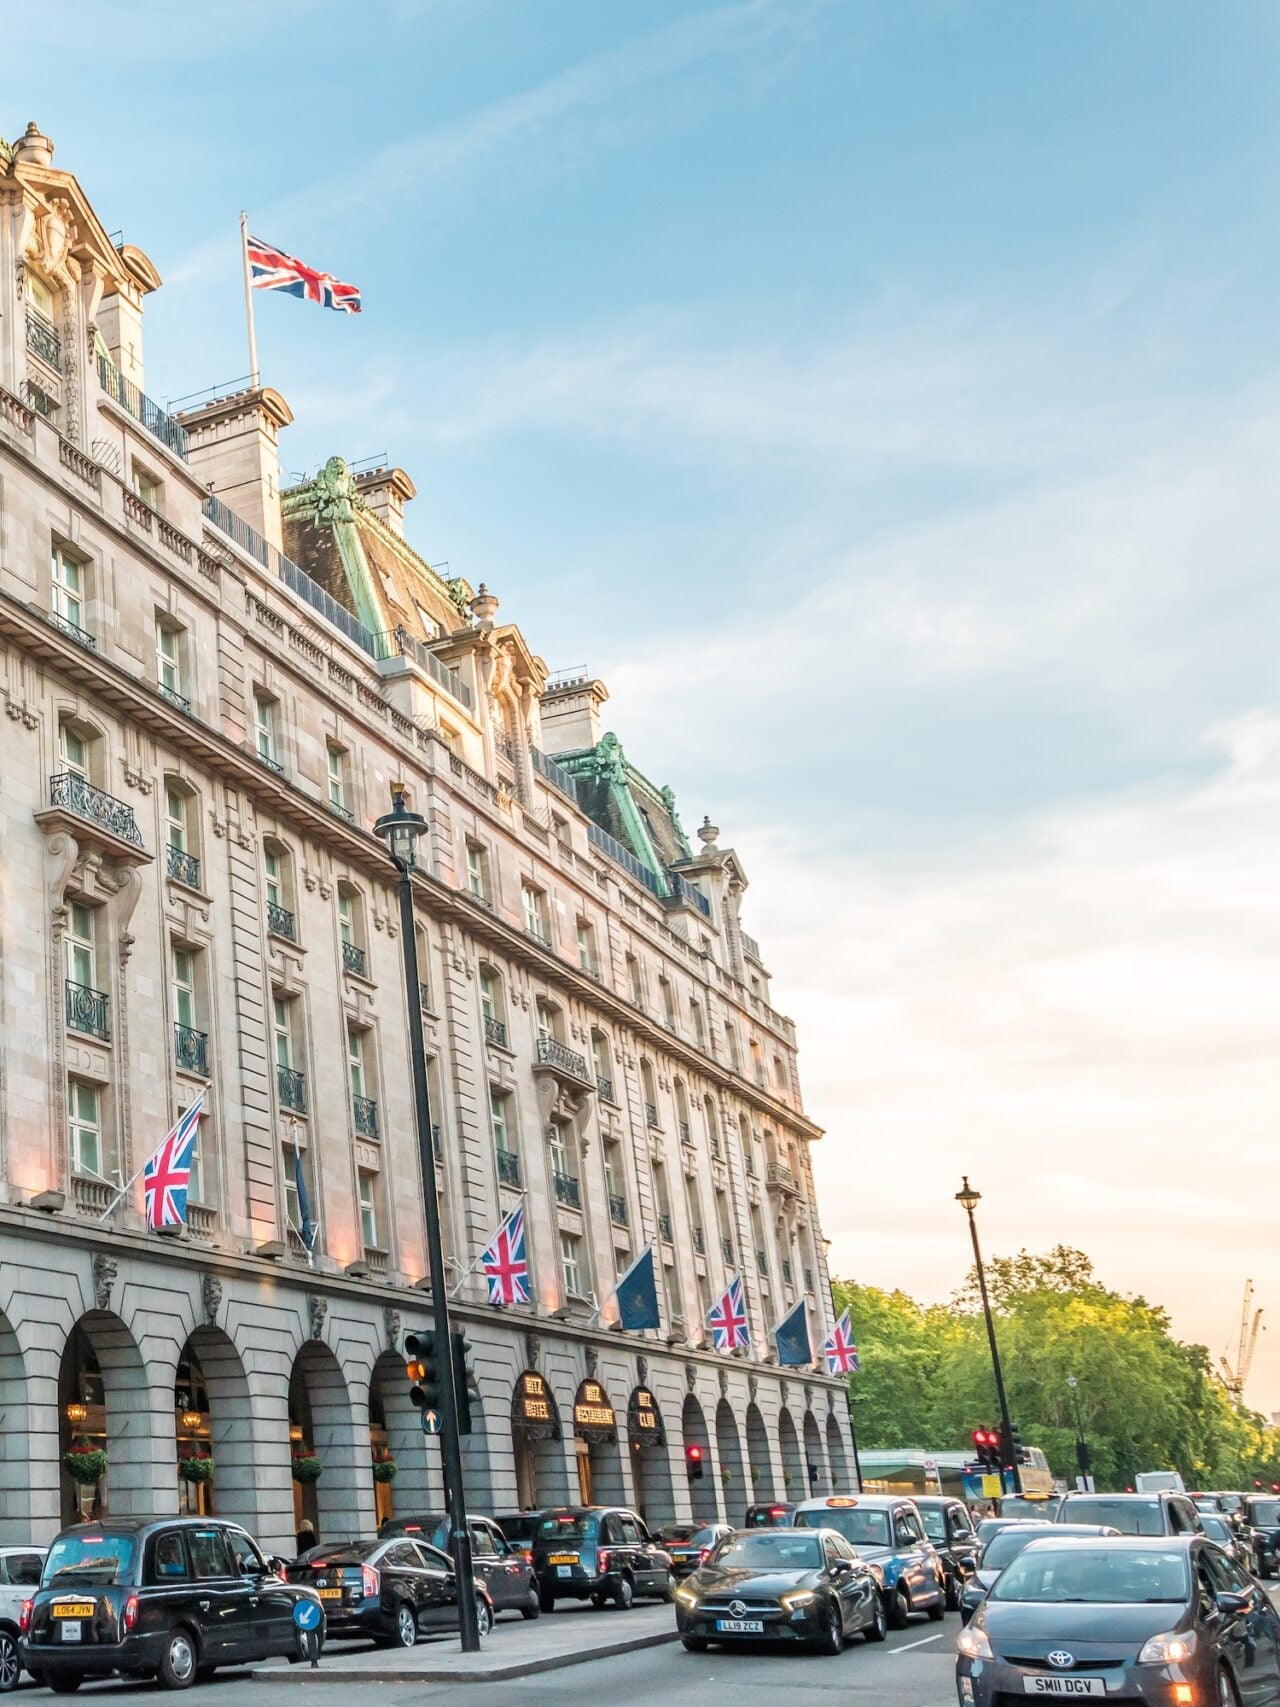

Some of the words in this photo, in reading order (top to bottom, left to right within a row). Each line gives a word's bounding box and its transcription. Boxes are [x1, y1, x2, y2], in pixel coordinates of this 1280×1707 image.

[742, 1622, 760, 1631] ZCZ
[1035, 1679, 1061, 1691] SM11
[1064, 1680, 1091, 1693] DGV
